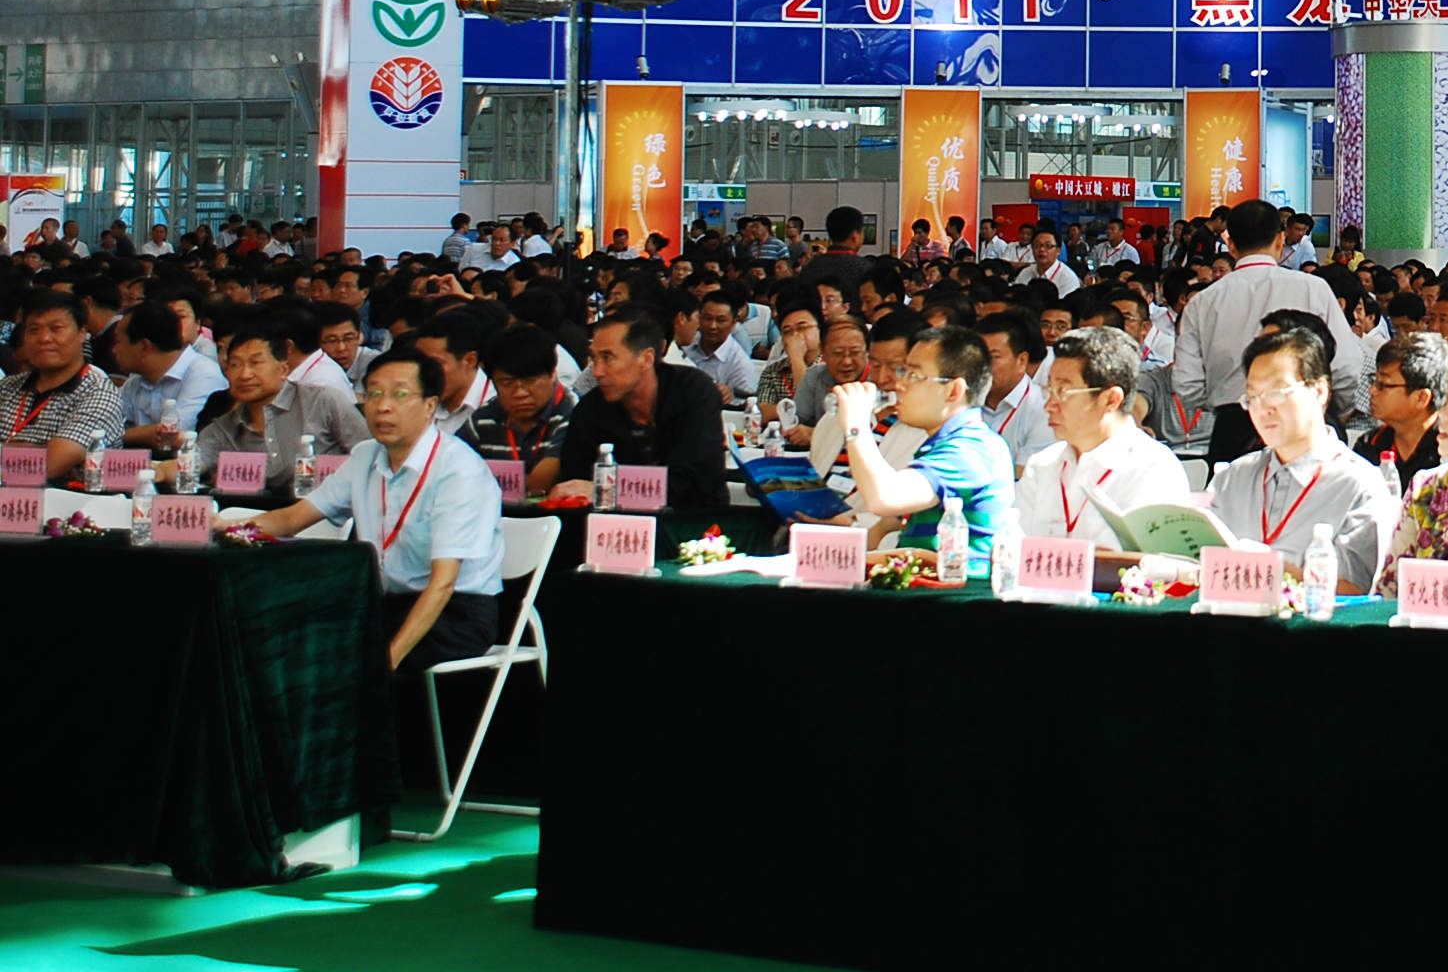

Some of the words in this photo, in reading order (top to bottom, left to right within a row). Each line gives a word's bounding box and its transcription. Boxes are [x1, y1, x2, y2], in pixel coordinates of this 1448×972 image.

[631, 163, 645, 211] Green
[644, 132, 667, 189] 绿色
[924, 156, 941, 203] Quality
[941, 136, 965, 192] 优质
[1222, 136, 1247, 193] 健康
